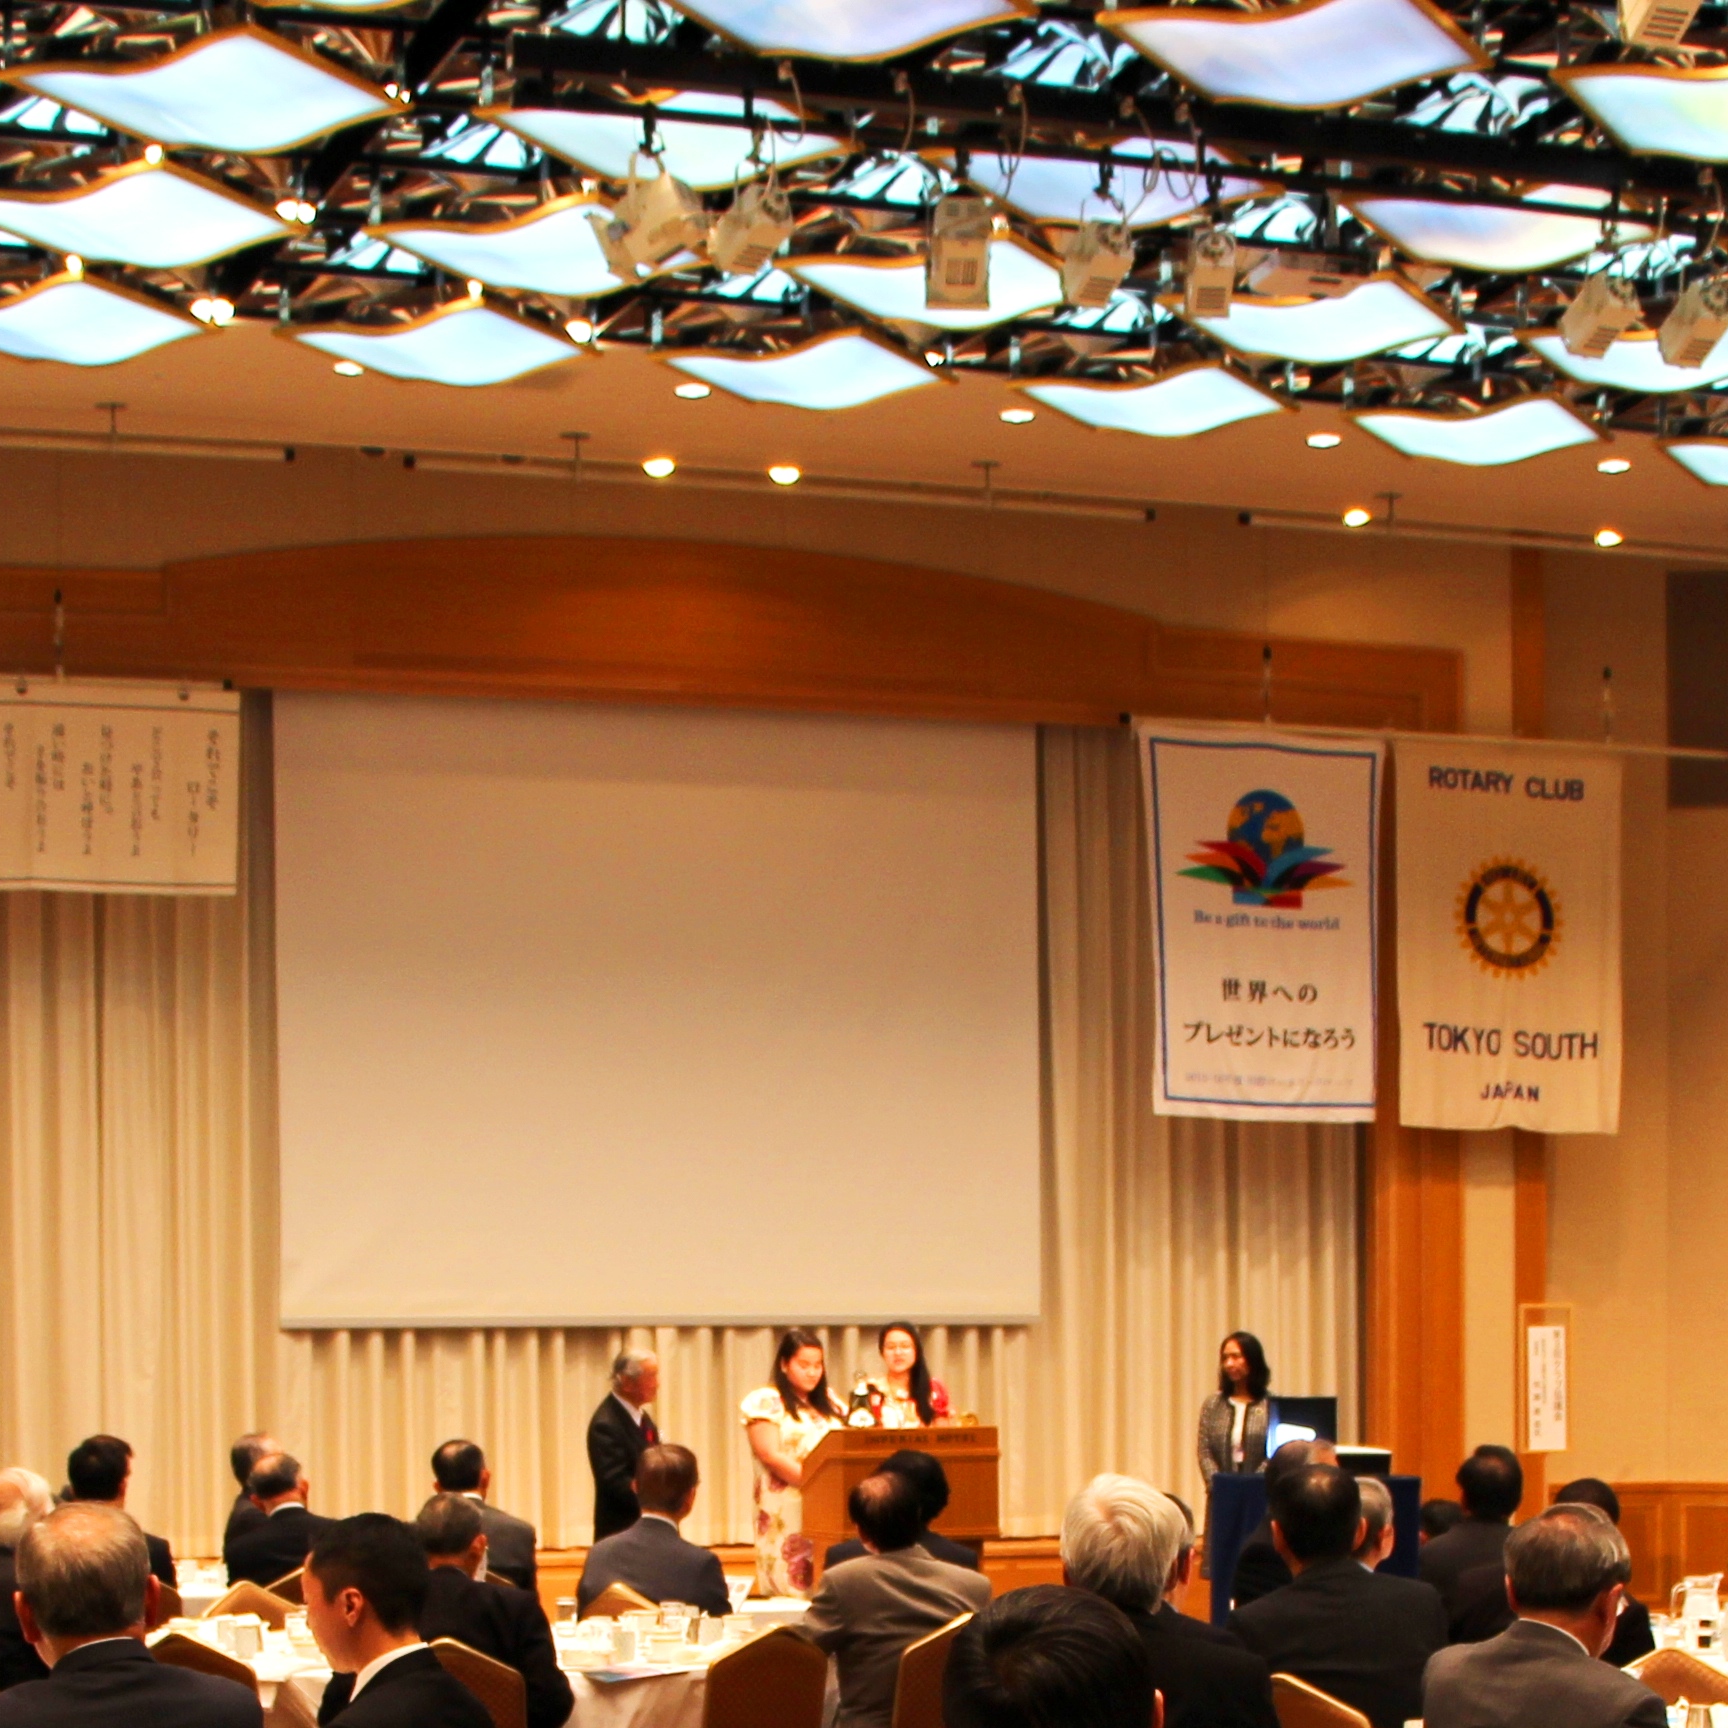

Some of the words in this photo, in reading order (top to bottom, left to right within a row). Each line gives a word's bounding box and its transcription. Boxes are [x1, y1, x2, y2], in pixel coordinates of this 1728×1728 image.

[1429, 766, 1514, 793] ROTARY
[1525, 776, 1585, 801] CLUB
[1194, 909, 1212, 923] Be
[1226, 912, 1251, 928] gift
[1271, 915, 1294, 929] the
[1298, 917, 1341, 930] world
[1222, 977, 1318, 1003] 世界への
[1183, 1020, 1356, 1049] プレゼントになろう
[1423, 1022, 1502, 1056] TOKYO
[1513, 1030, 1599, 1060] SOUTH
[1480, 1081, 1540, 1101] JAPAN
